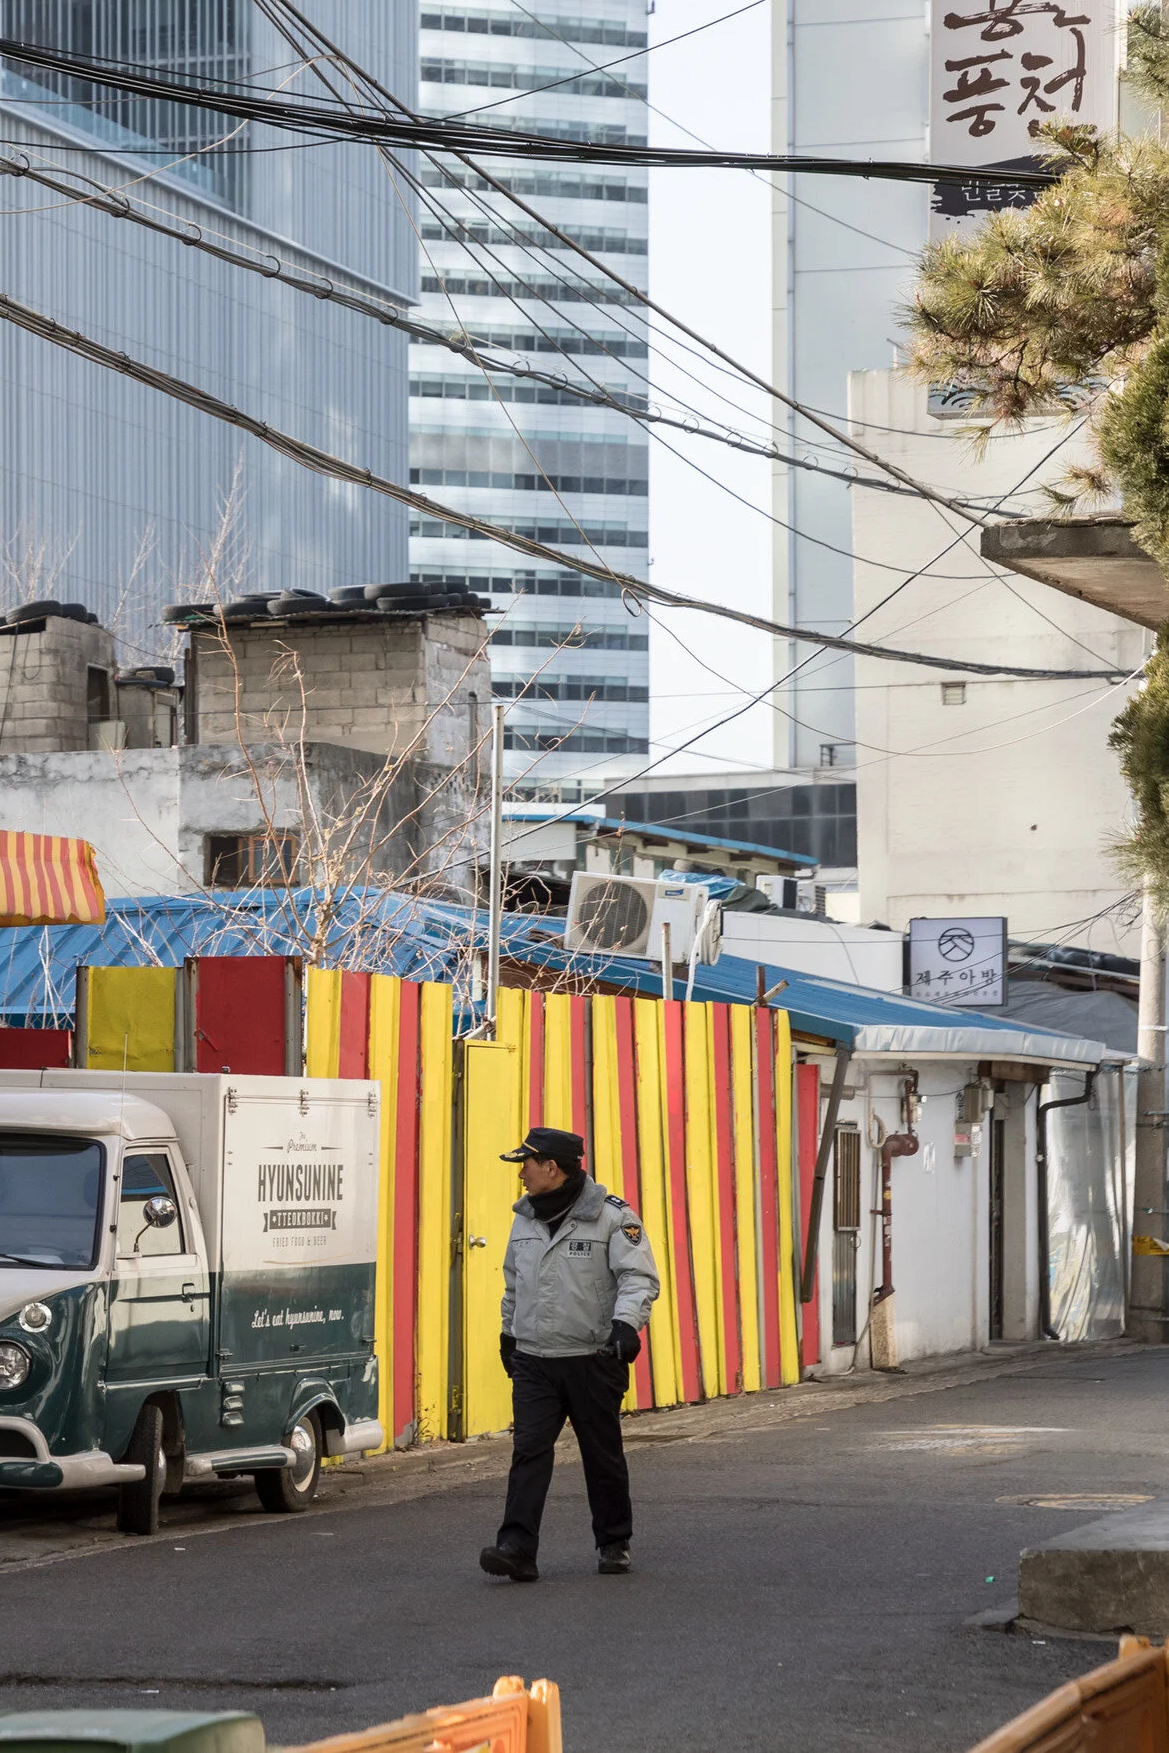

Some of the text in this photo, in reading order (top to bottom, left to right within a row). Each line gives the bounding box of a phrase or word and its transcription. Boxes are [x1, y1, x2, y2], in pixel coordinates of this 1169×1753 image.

[916, 969, 997, 986] 제주아방
[286, 1139, 318, 1153] Premium
[258, 1164, 344, 1202] HYUNSUNINE
[277, 1211, 324, 1226] TTEOKBOKKI
[251, 1308, 271, 1328] Let's
[272, 1309, 284, 1326] eat
